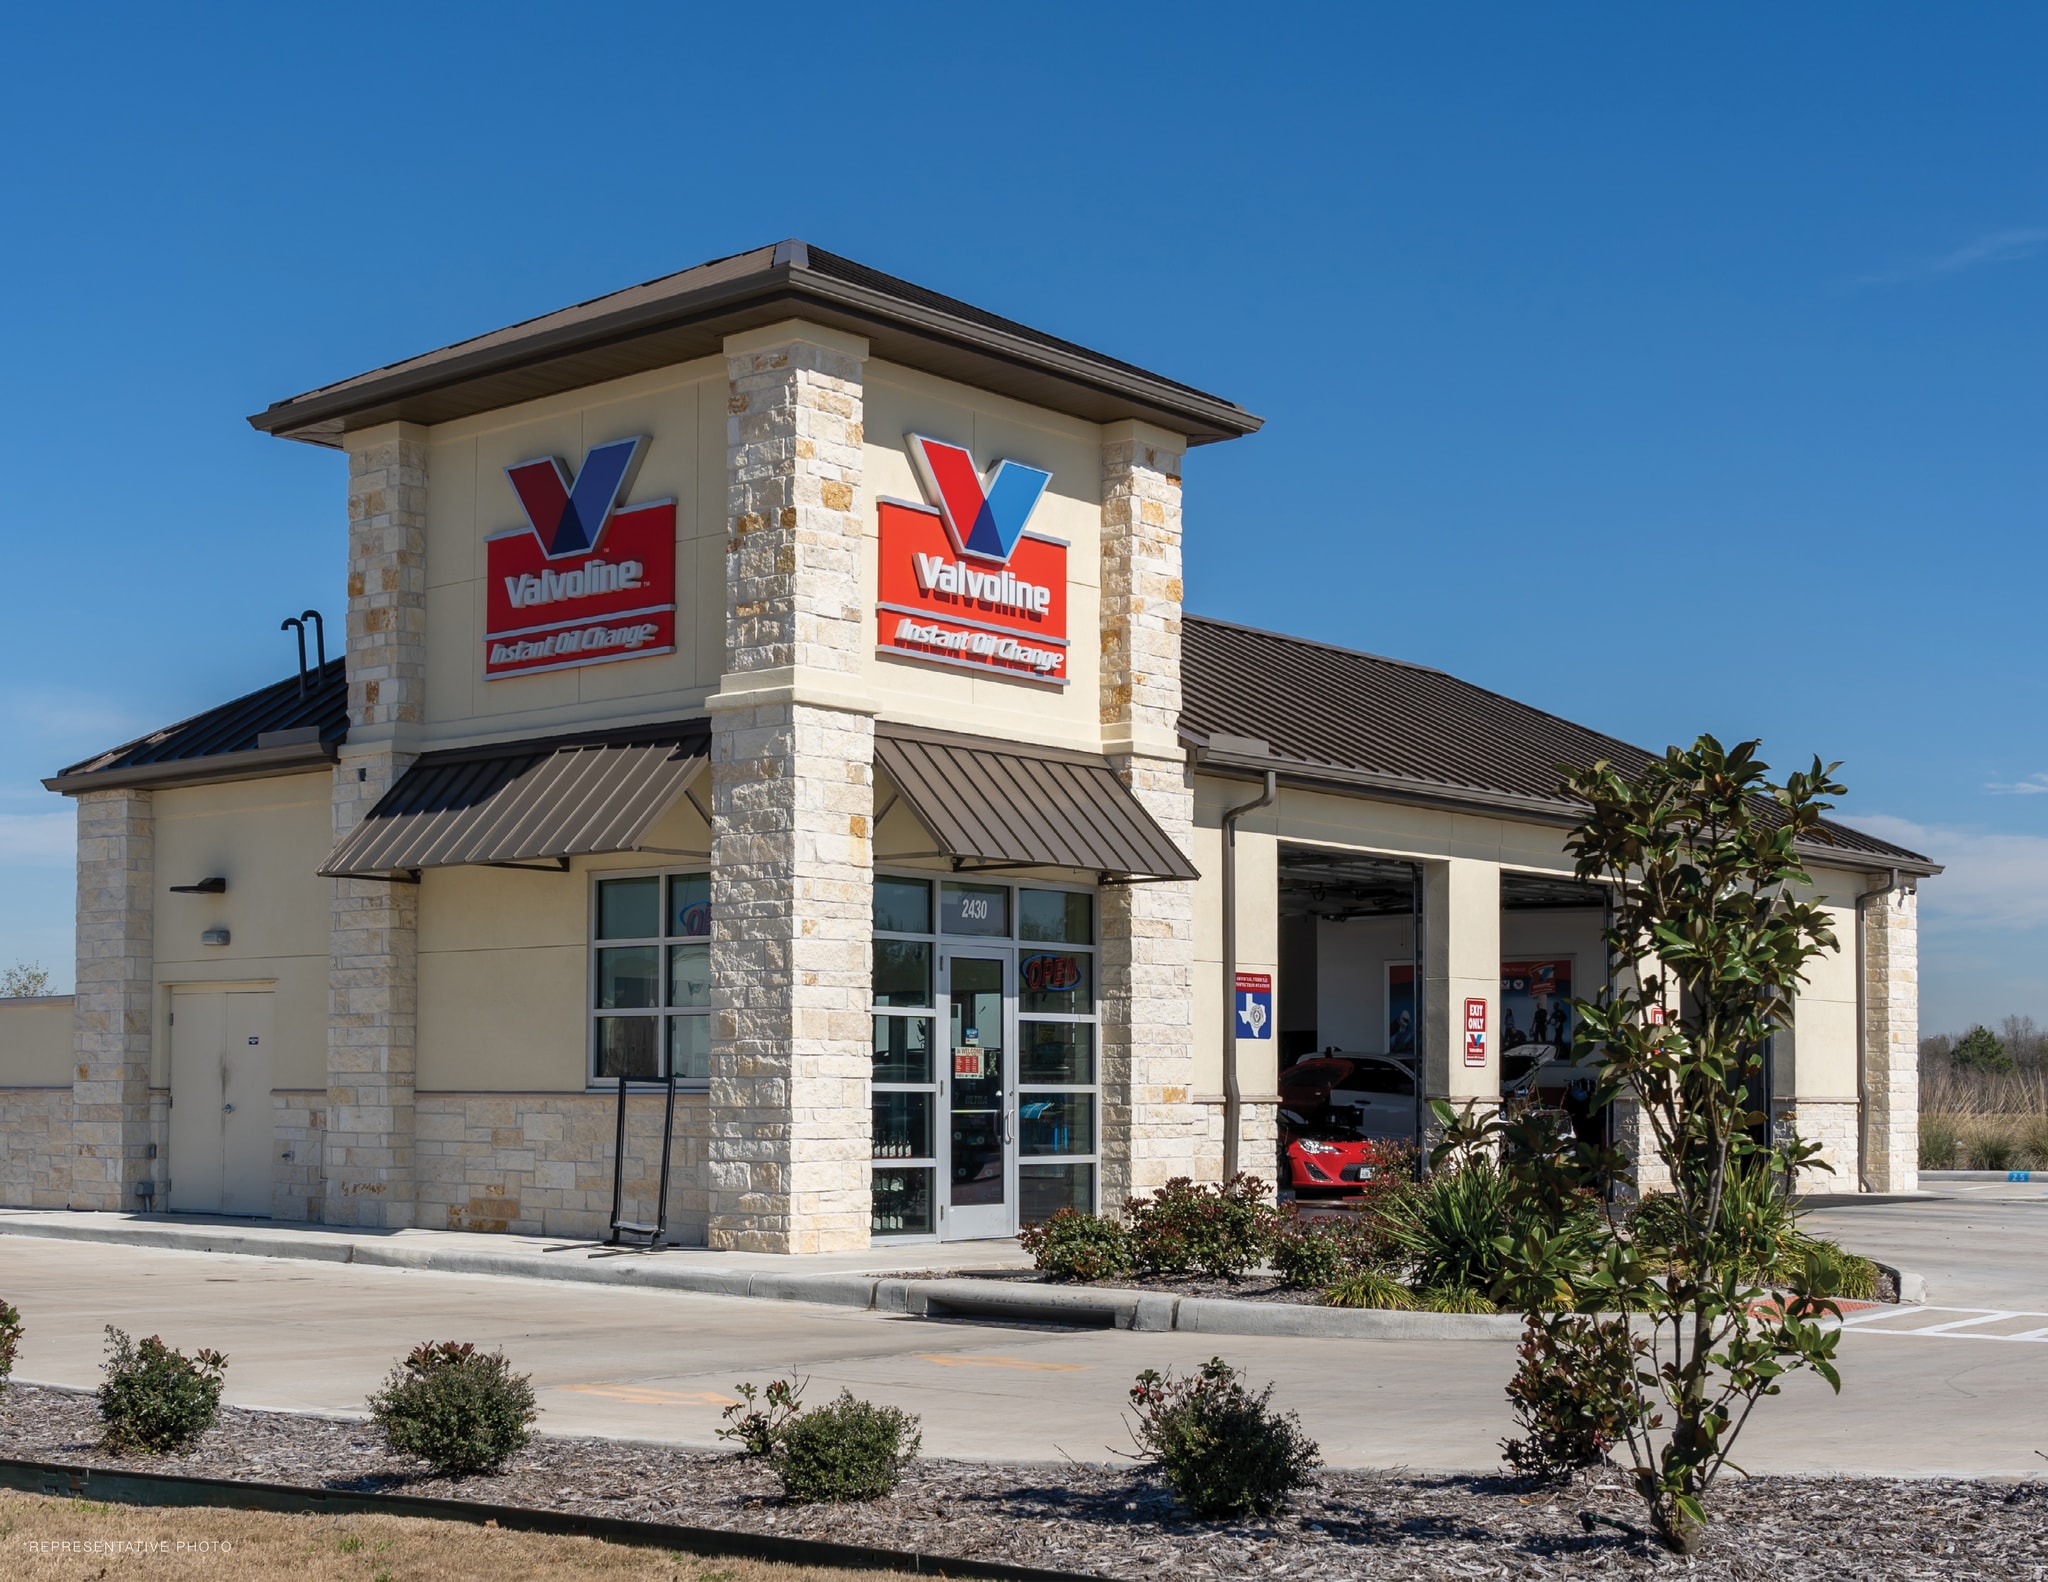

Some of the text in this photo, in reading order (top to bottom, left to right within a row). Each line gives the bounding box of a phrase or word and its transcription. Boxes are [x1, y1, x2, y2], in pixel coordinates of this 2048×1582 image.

[505, 559, 643, 608] Valvoline
[913, 552, 1050, 616] Valvoline
[489, 623, 658, 665] Instant Oil Change
[894, 618, 1064, 671] Instant Oil Change
[961, 898, 988, 919] 2430
[1029, 957, 1077, 989] OPEN
[1468, 1018, 1484, 1030] ONLY
[1469, 1004, 1483, 1016] EXIT
